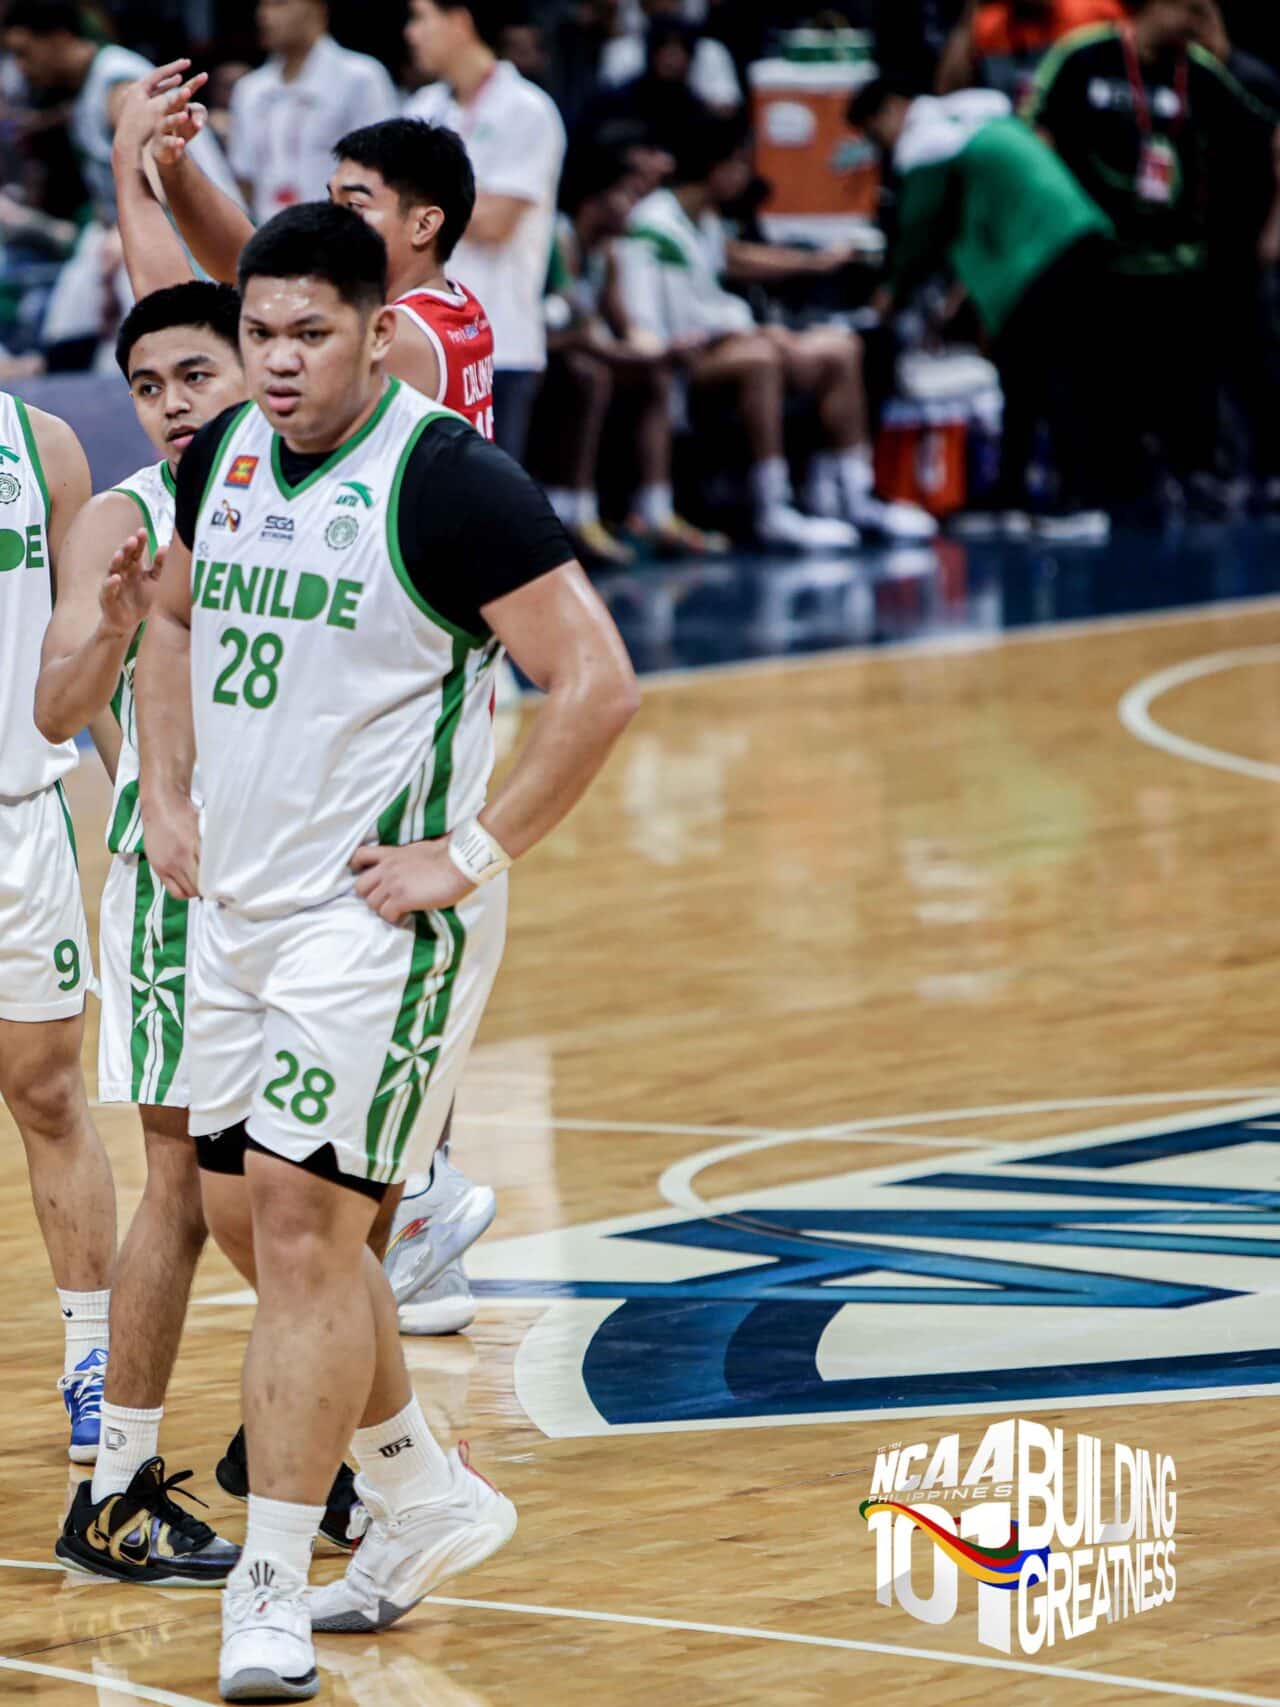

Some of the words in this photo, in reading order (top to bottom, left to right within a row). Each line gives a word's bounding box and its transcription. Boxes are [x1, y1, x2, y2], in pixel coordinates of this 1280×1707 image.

[212, 626, 284, 711] 28
[53, 939, 81, 992] 9
[263, 1050, 338, 1126] 28
